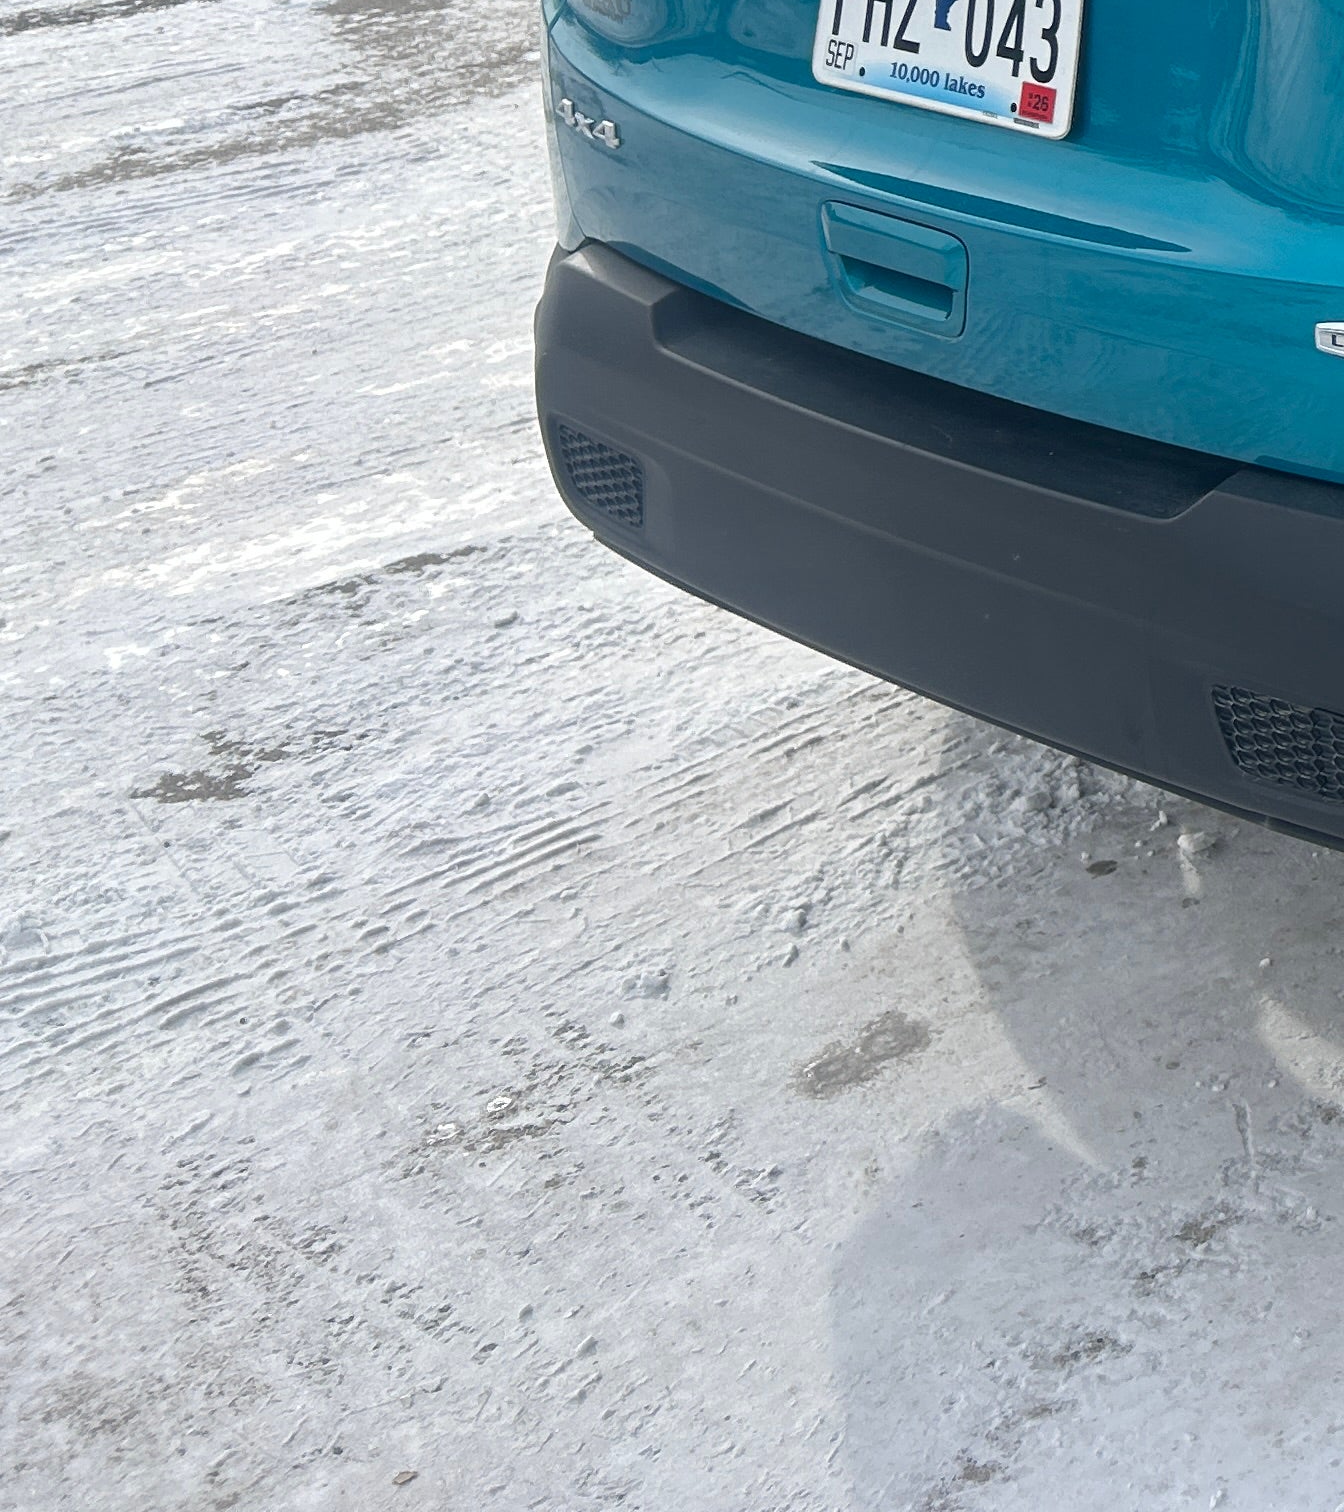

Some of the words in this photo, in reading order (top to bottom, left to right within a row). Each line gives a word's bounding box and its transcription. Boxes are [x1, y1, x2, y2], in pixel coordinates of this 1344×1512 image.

[825, 38, 855, 71] SEP
[889, 61, 940, 88] 10,000
[943, 72, 986, 100] lakes
[555, 98, 620, 150] 4x4
